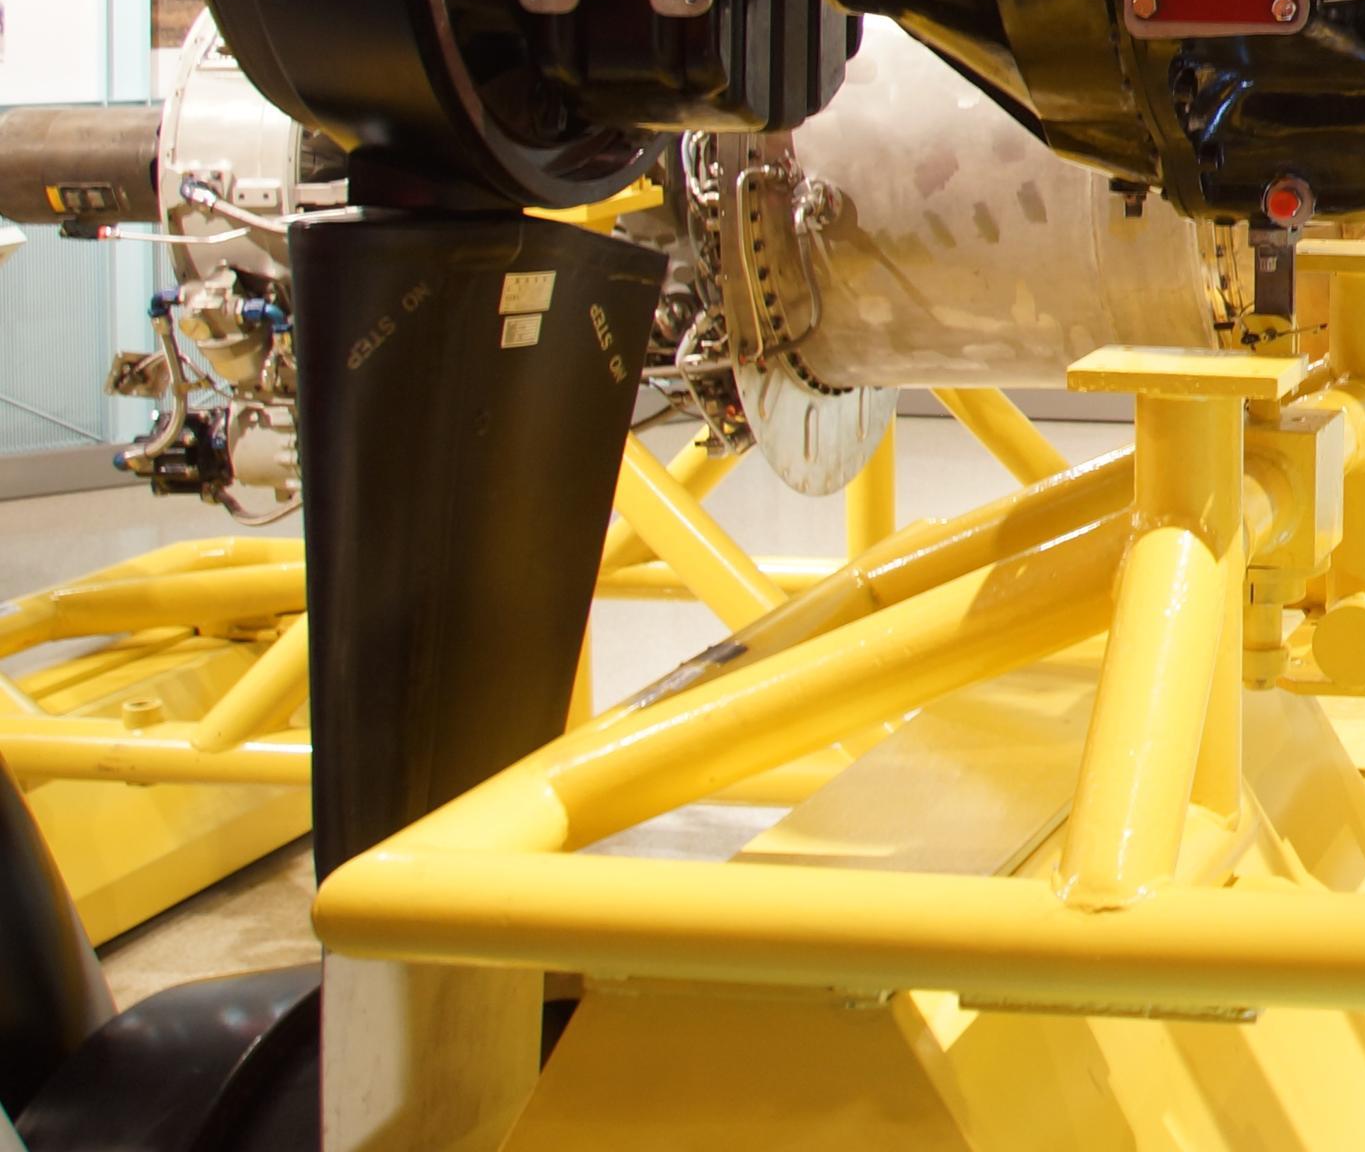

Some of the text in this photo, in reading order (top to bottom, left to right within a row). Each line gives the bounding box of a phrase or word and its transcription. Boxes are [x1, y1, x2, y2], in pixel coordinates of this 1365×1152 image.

[347, 282, 431, 369] NO STEP
[590, 303, 628, 384] NO STEP
